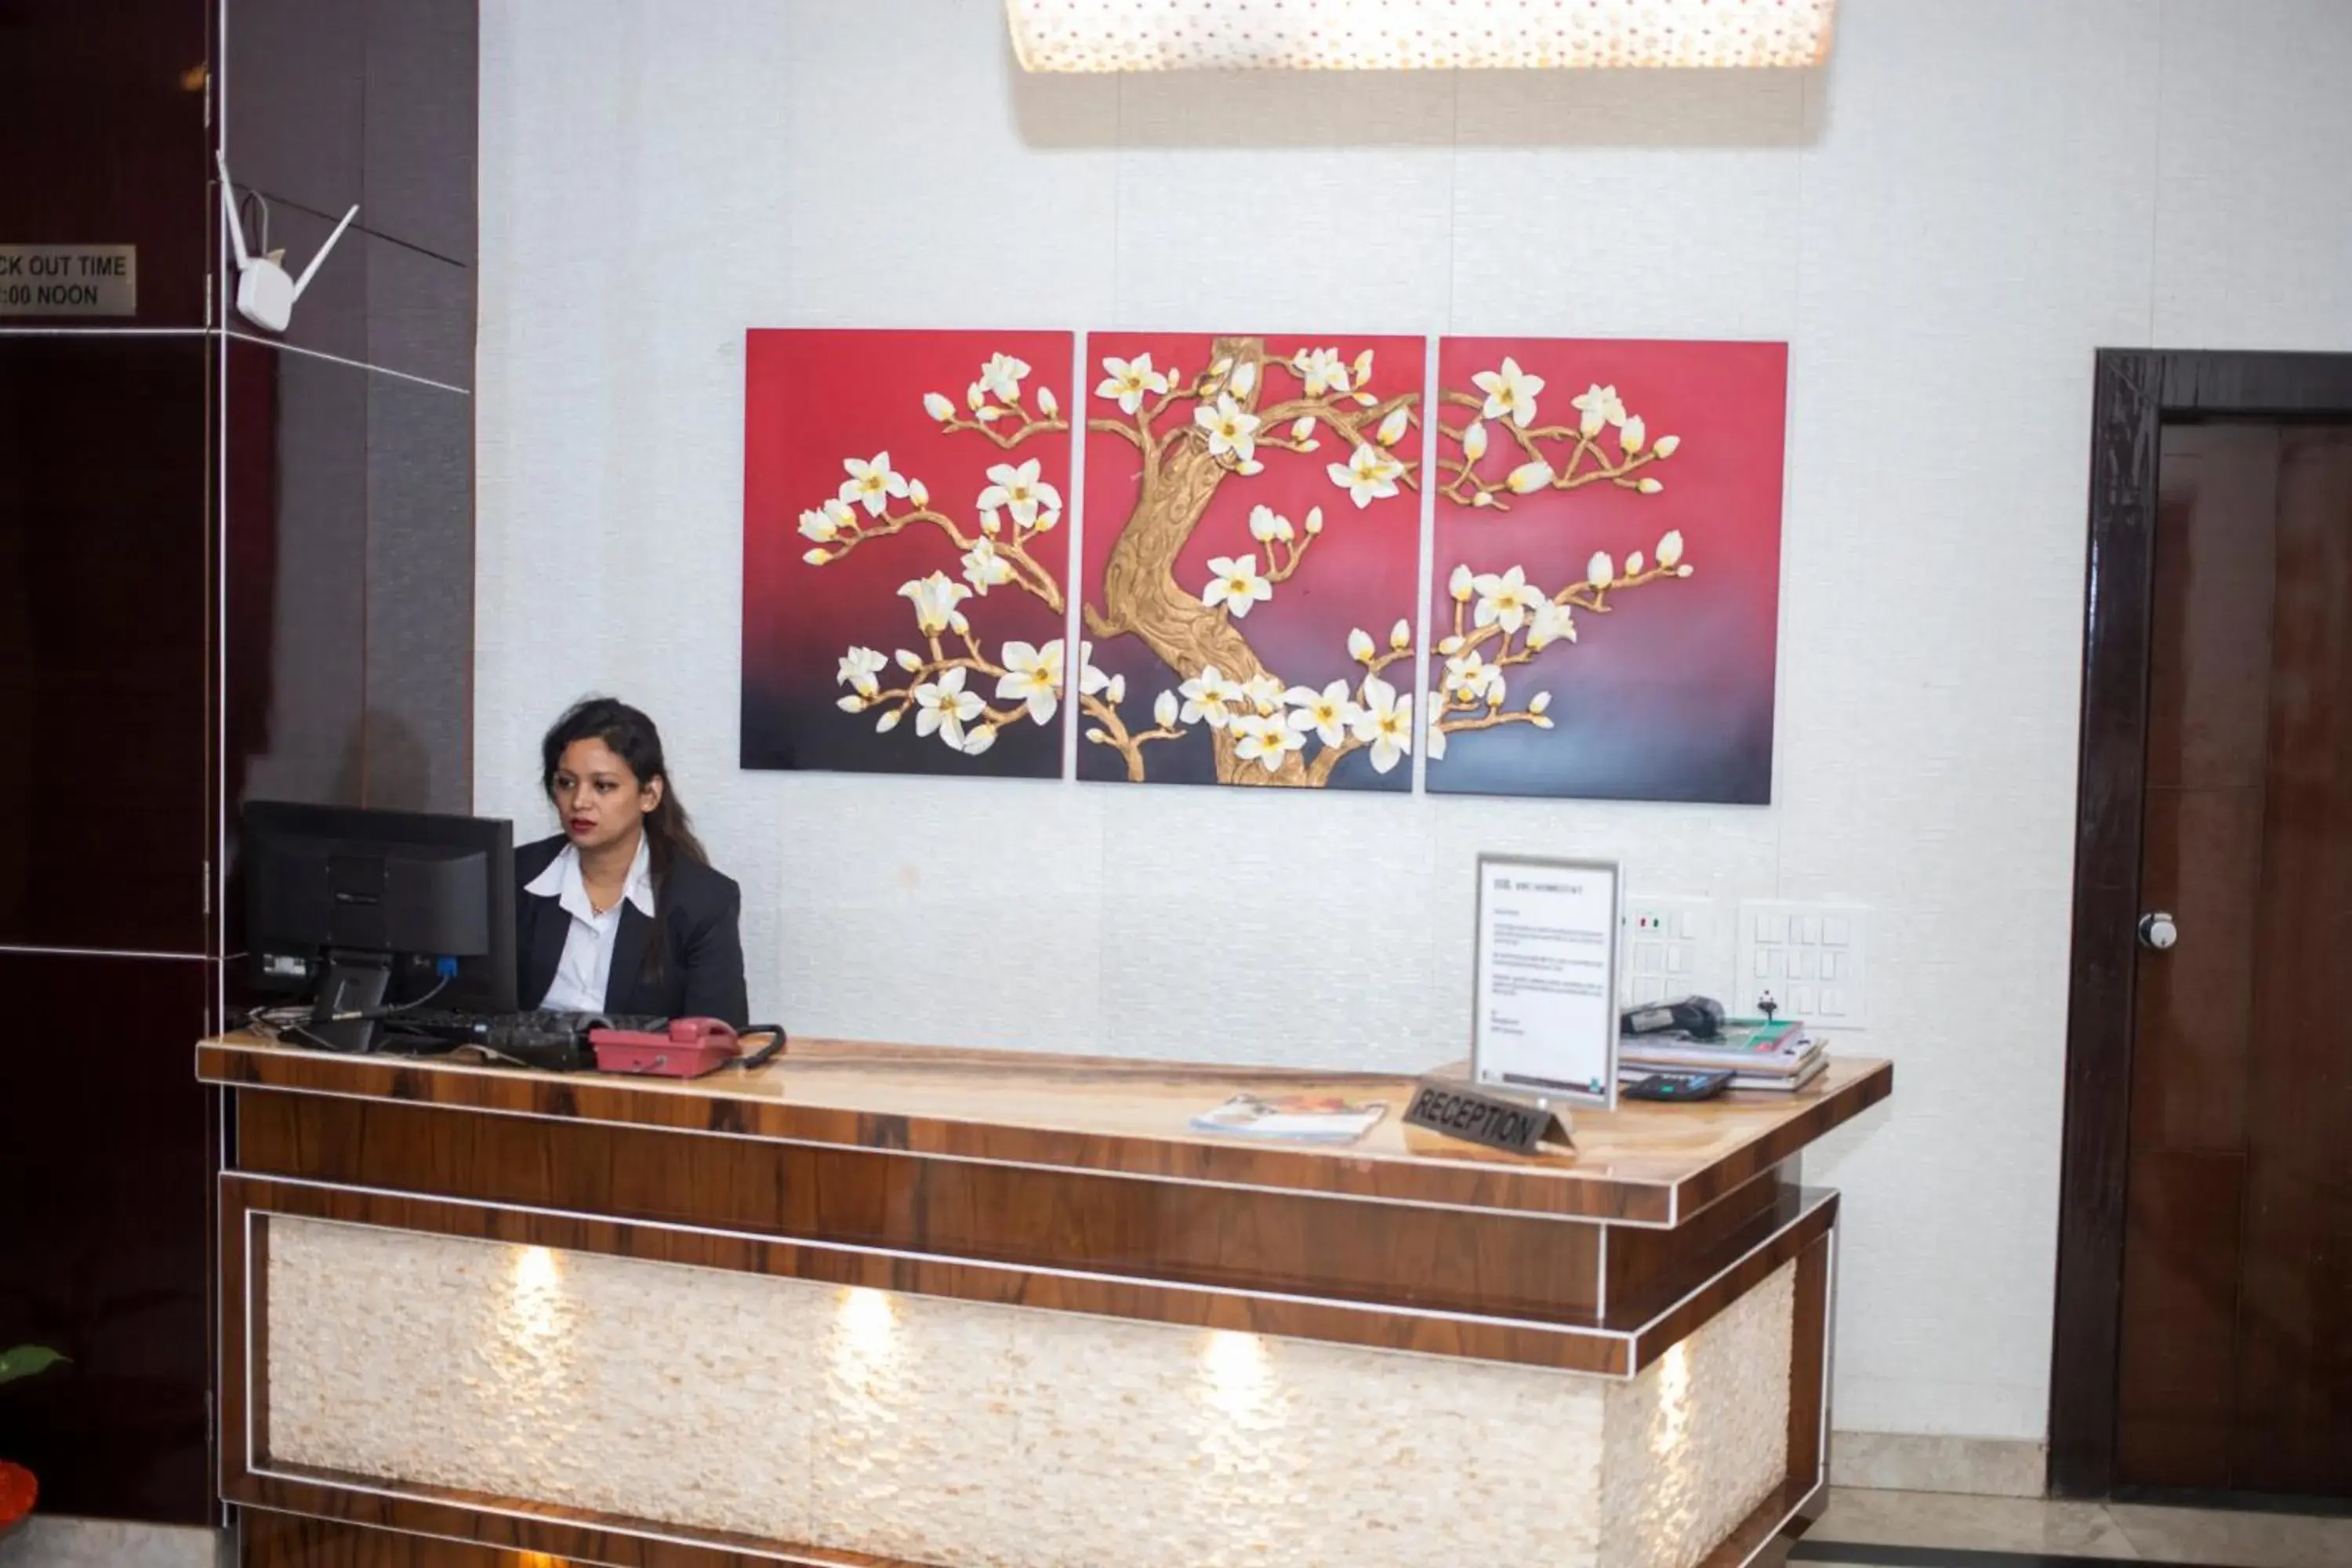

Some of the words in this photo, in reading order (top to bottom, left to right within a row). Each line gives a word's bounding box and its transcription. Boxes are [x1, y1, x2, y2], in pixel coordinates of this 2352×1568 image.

[29, 256, 71, 276] OUT
[77, 256, 126, 276] TIME
[0, 285, 31, 305] :00
[38, 285, 98, 305] NOON
[1413, 1088, 1536, 1147] RECEPTION
